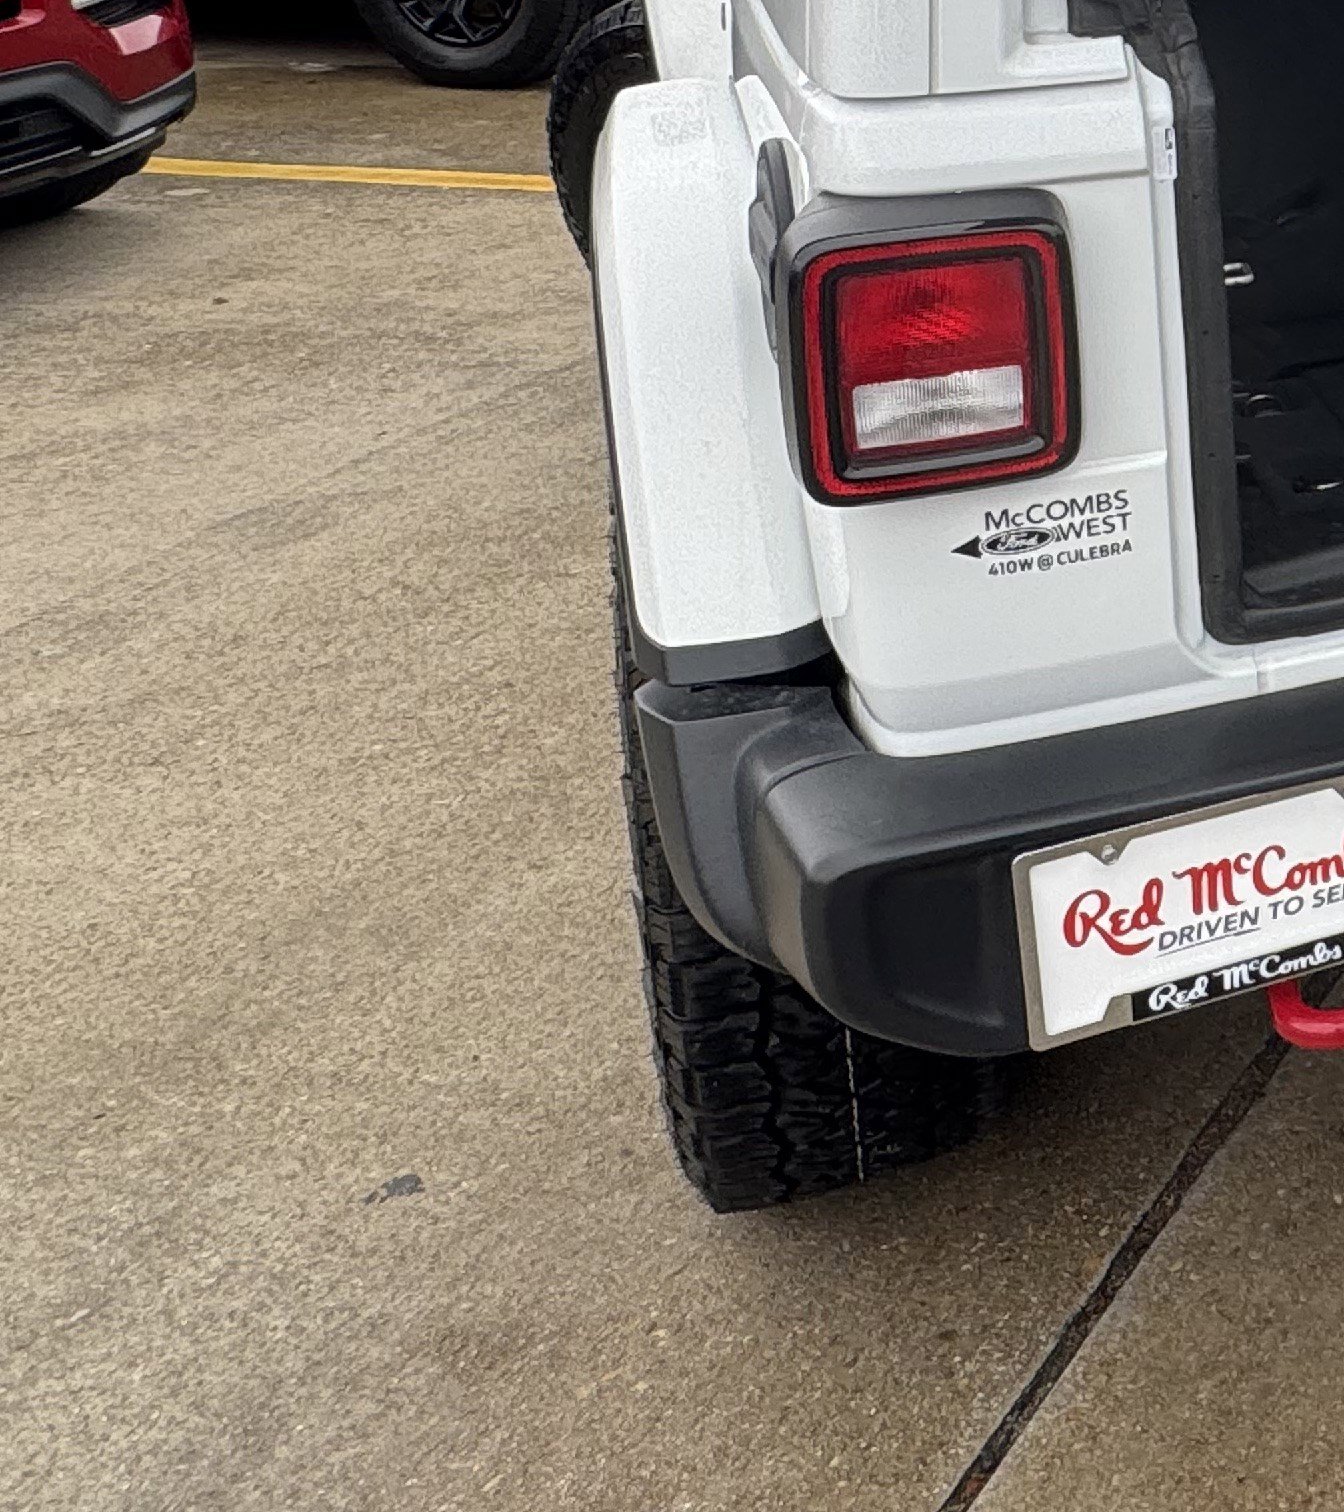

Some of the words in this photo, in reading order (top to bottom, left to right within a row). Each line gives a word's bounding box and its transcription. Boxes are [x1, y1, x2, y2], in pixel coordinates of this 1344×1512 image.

[984, 489, 1129, 531] McCOMBS
[1058, 511, 1132, 540] WEST
[988, 556, 1034, 576] 410W
[1036, 553, 1055, 571] @
[1056, 538, 1133, 566] CULEBRA
[1063, 878, 1166, 956] Red
[1158, 906, 1260, 952] DRIVEN
[1268, 896, 1305, 920] TO
[1149, 977, 1211, 1013] Red
[1216, 942, 1343, 991] McCombs
